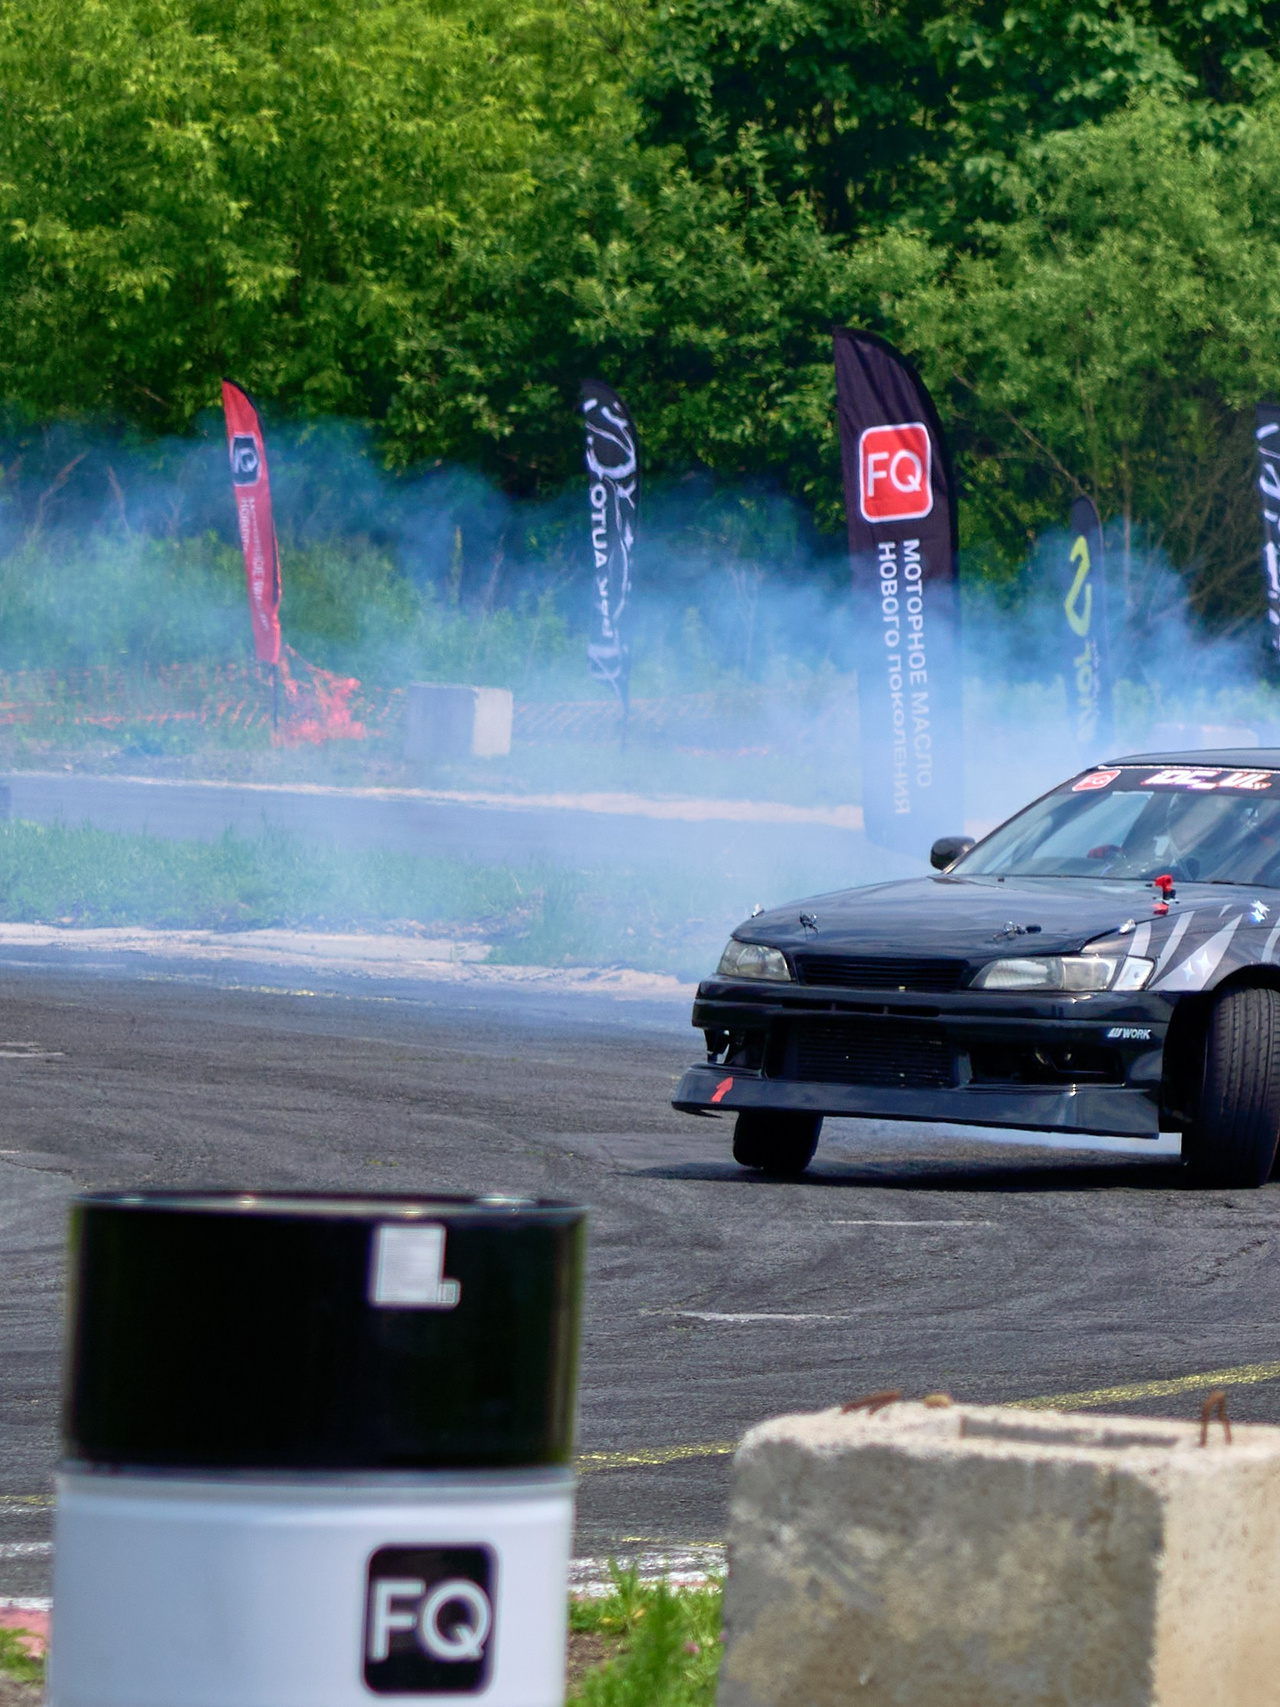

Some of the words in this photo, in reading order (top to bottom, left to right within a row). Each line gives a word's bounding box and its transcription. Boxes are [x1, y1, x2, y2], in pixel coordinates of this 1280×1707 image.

[868, 449, 922, 497] FQ
[878, 541, 900, 648] НОВОГО
[903, 538, 928, 686] МОТОРНОЕ
[887, 653, 911, 815] ПОКОЛЕНИЯ
[912, 691, 933, 788] МАСЛО
[1123, 1027, 1151, 1040] WORK
[372, 1579, 491, 1660] FQ
